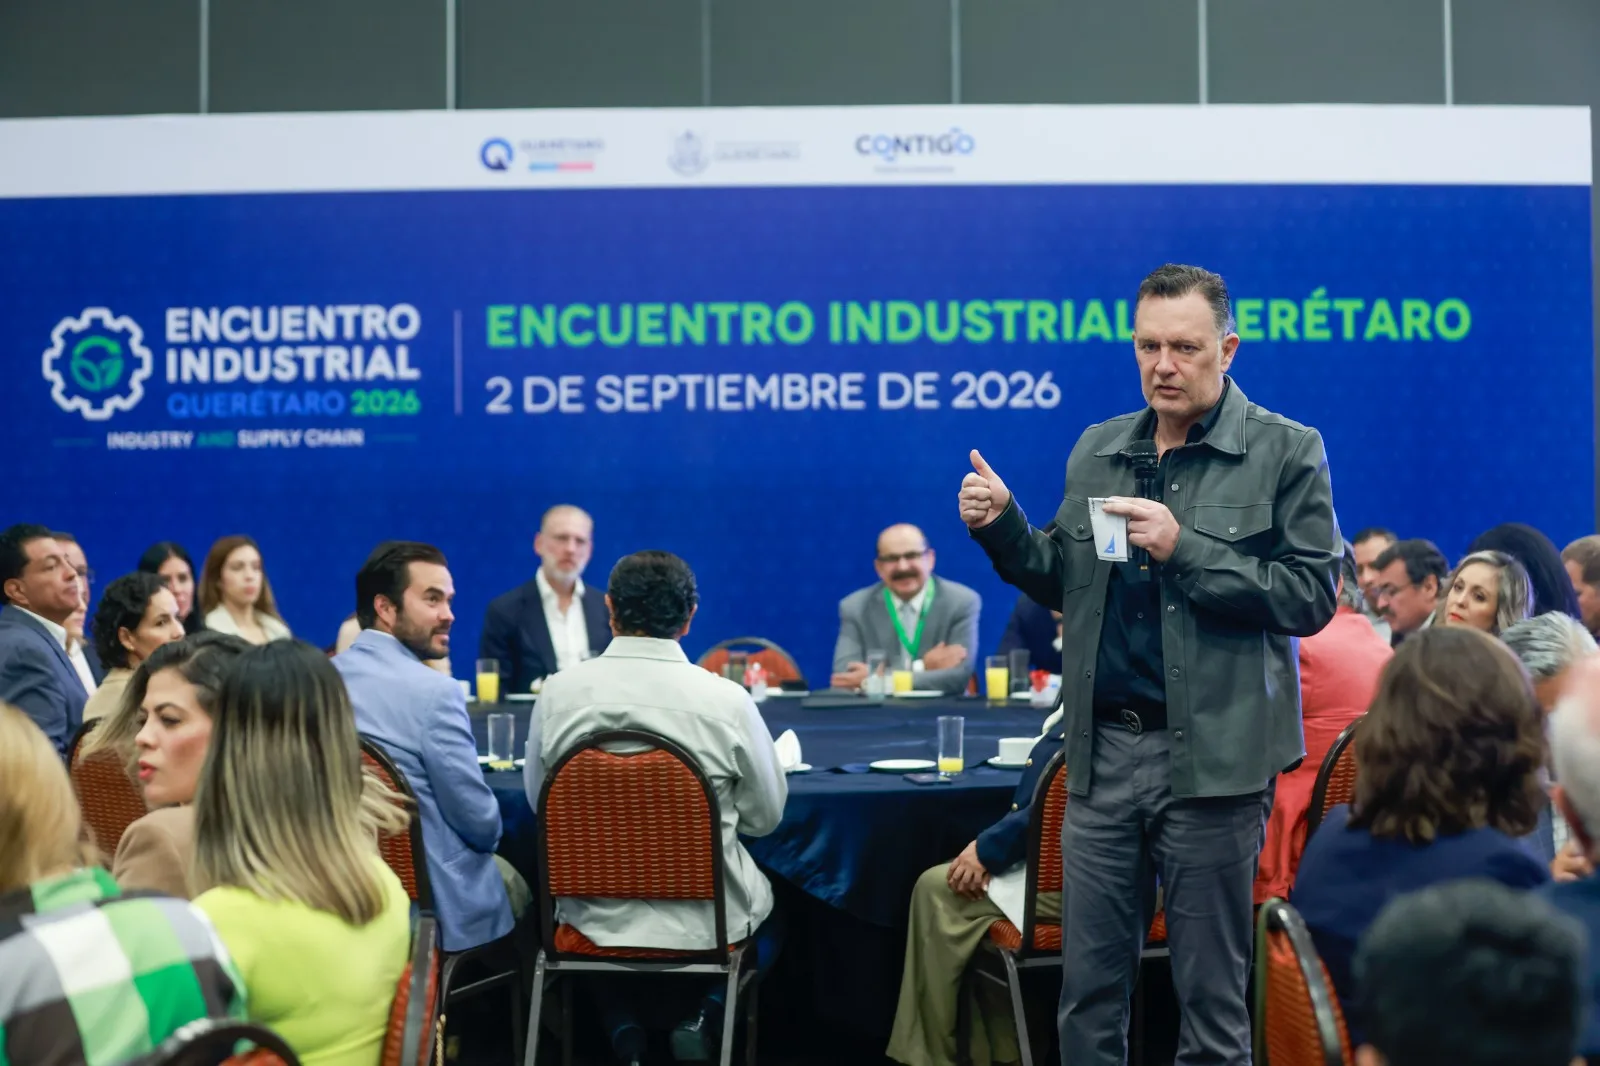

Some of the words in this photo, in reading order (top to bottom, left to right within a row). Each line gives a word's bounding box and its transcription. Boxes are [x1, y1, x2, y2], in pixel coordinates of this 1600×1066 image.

[855, 129, 977, 160] CONTIGO
[165, 303, 421, 343] ENCUENTRO
[485, 301, 814, 348] ENCUENTRO
[828, 298, 1136, 344] INDUSTRIAL
[1234, 286, 1472, 342] ERÉTARO
[165, 345, 421, 383] INDUSTRIAL
[166, 388, 347, 419] QUERÉTARO
[350, 388, 422, 416] 2026
[485, 375, 513, 414] 2
[522, 374, 586, 414] DE
[595, 371, 867, 413] SEPTIEMBRE
[877, 371, 941, 411] DE
[950, 370, 1063, 410] 2026
[106, 430, 195, 449] INDUSTRY
[196, 431, 236, 447] AND
[237, 428, 302, 448] SUPPLY
[303, 428, 365, 447] CHAIN
